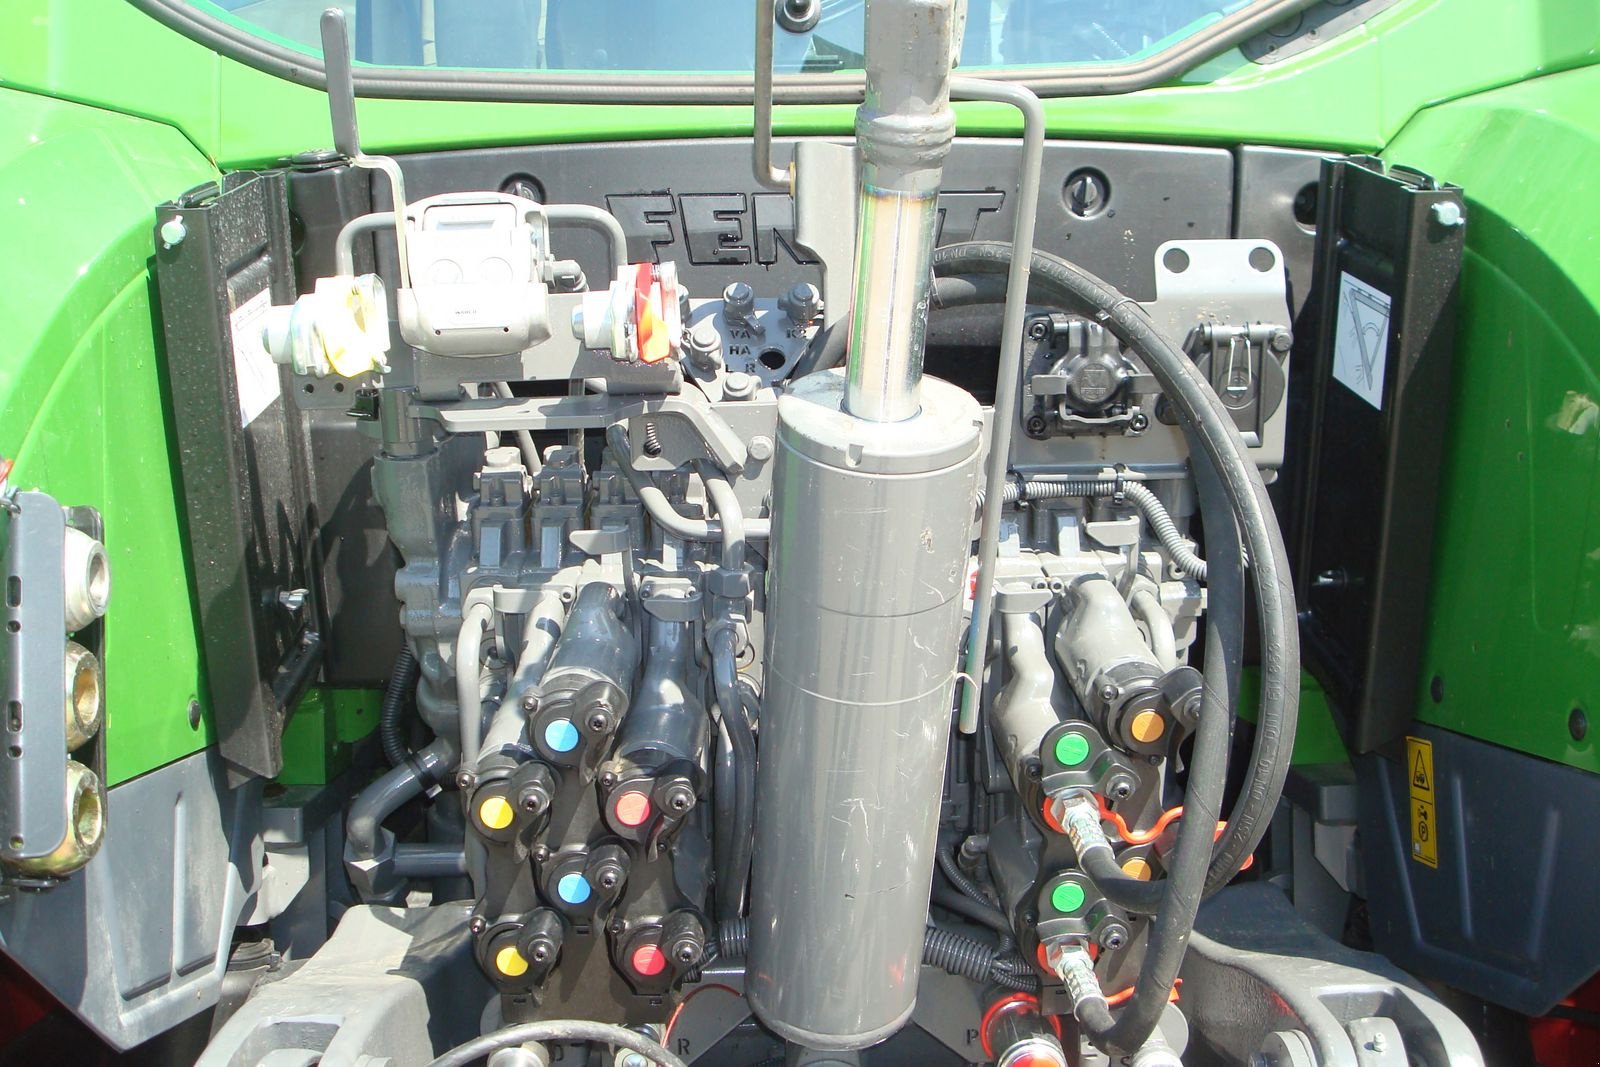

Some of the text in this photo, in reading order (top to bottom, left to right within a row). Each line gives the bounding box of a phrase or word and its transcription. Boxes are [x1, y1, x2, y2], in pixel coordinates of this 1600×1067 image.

[605, 192, 1006, 266] FENT
[729, 329, 751, 339] VA
[729, 345, 751, 355] HA
[967, 1028, 979, 1045] P
[677, 1038, 690, 1055] R
